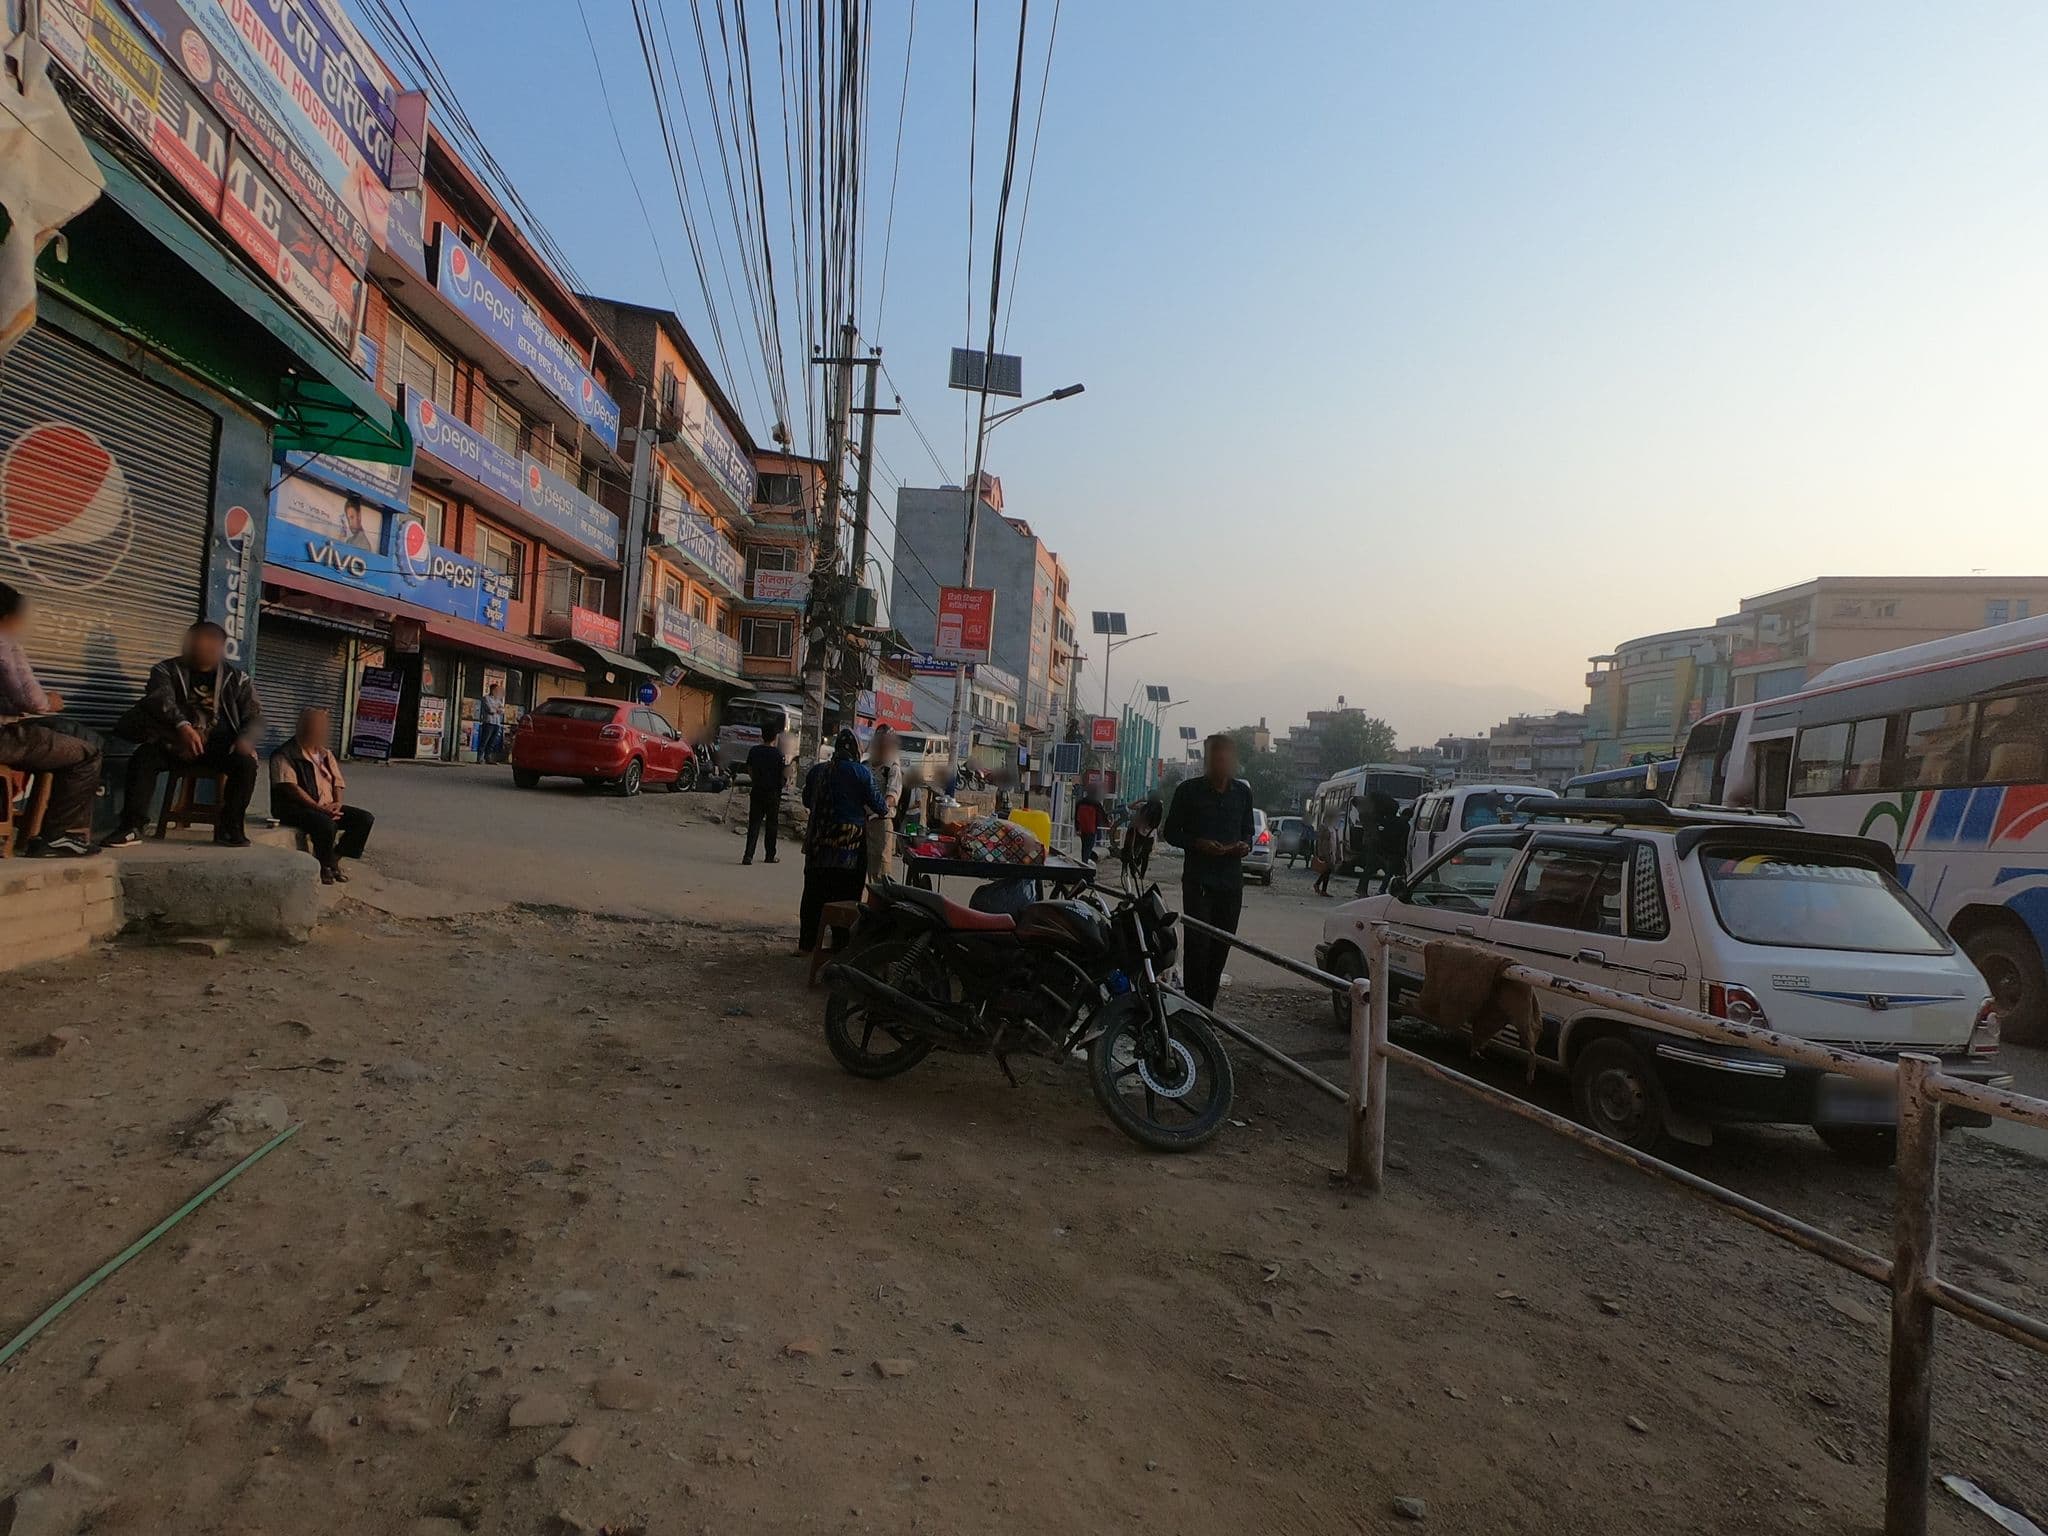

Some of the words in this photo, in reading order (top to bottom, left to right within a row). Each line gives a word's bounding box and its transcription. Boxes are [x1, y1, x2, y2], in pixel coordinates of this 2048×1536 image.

[231, 0, 288, 85] DENTAL
[292, 71, 350, 167] HOSPITAL
[185, 101, 282, 241] IME
[473, 279, 515, 330] pepsi
[592, 400, 618, 431] pepsi
[441, 423, 480, 462] pepsi
[543, 485, 574, 518] pepsi
[307, 540, 367, 577] vivo
[433, 556, 477, 589] pepsi
